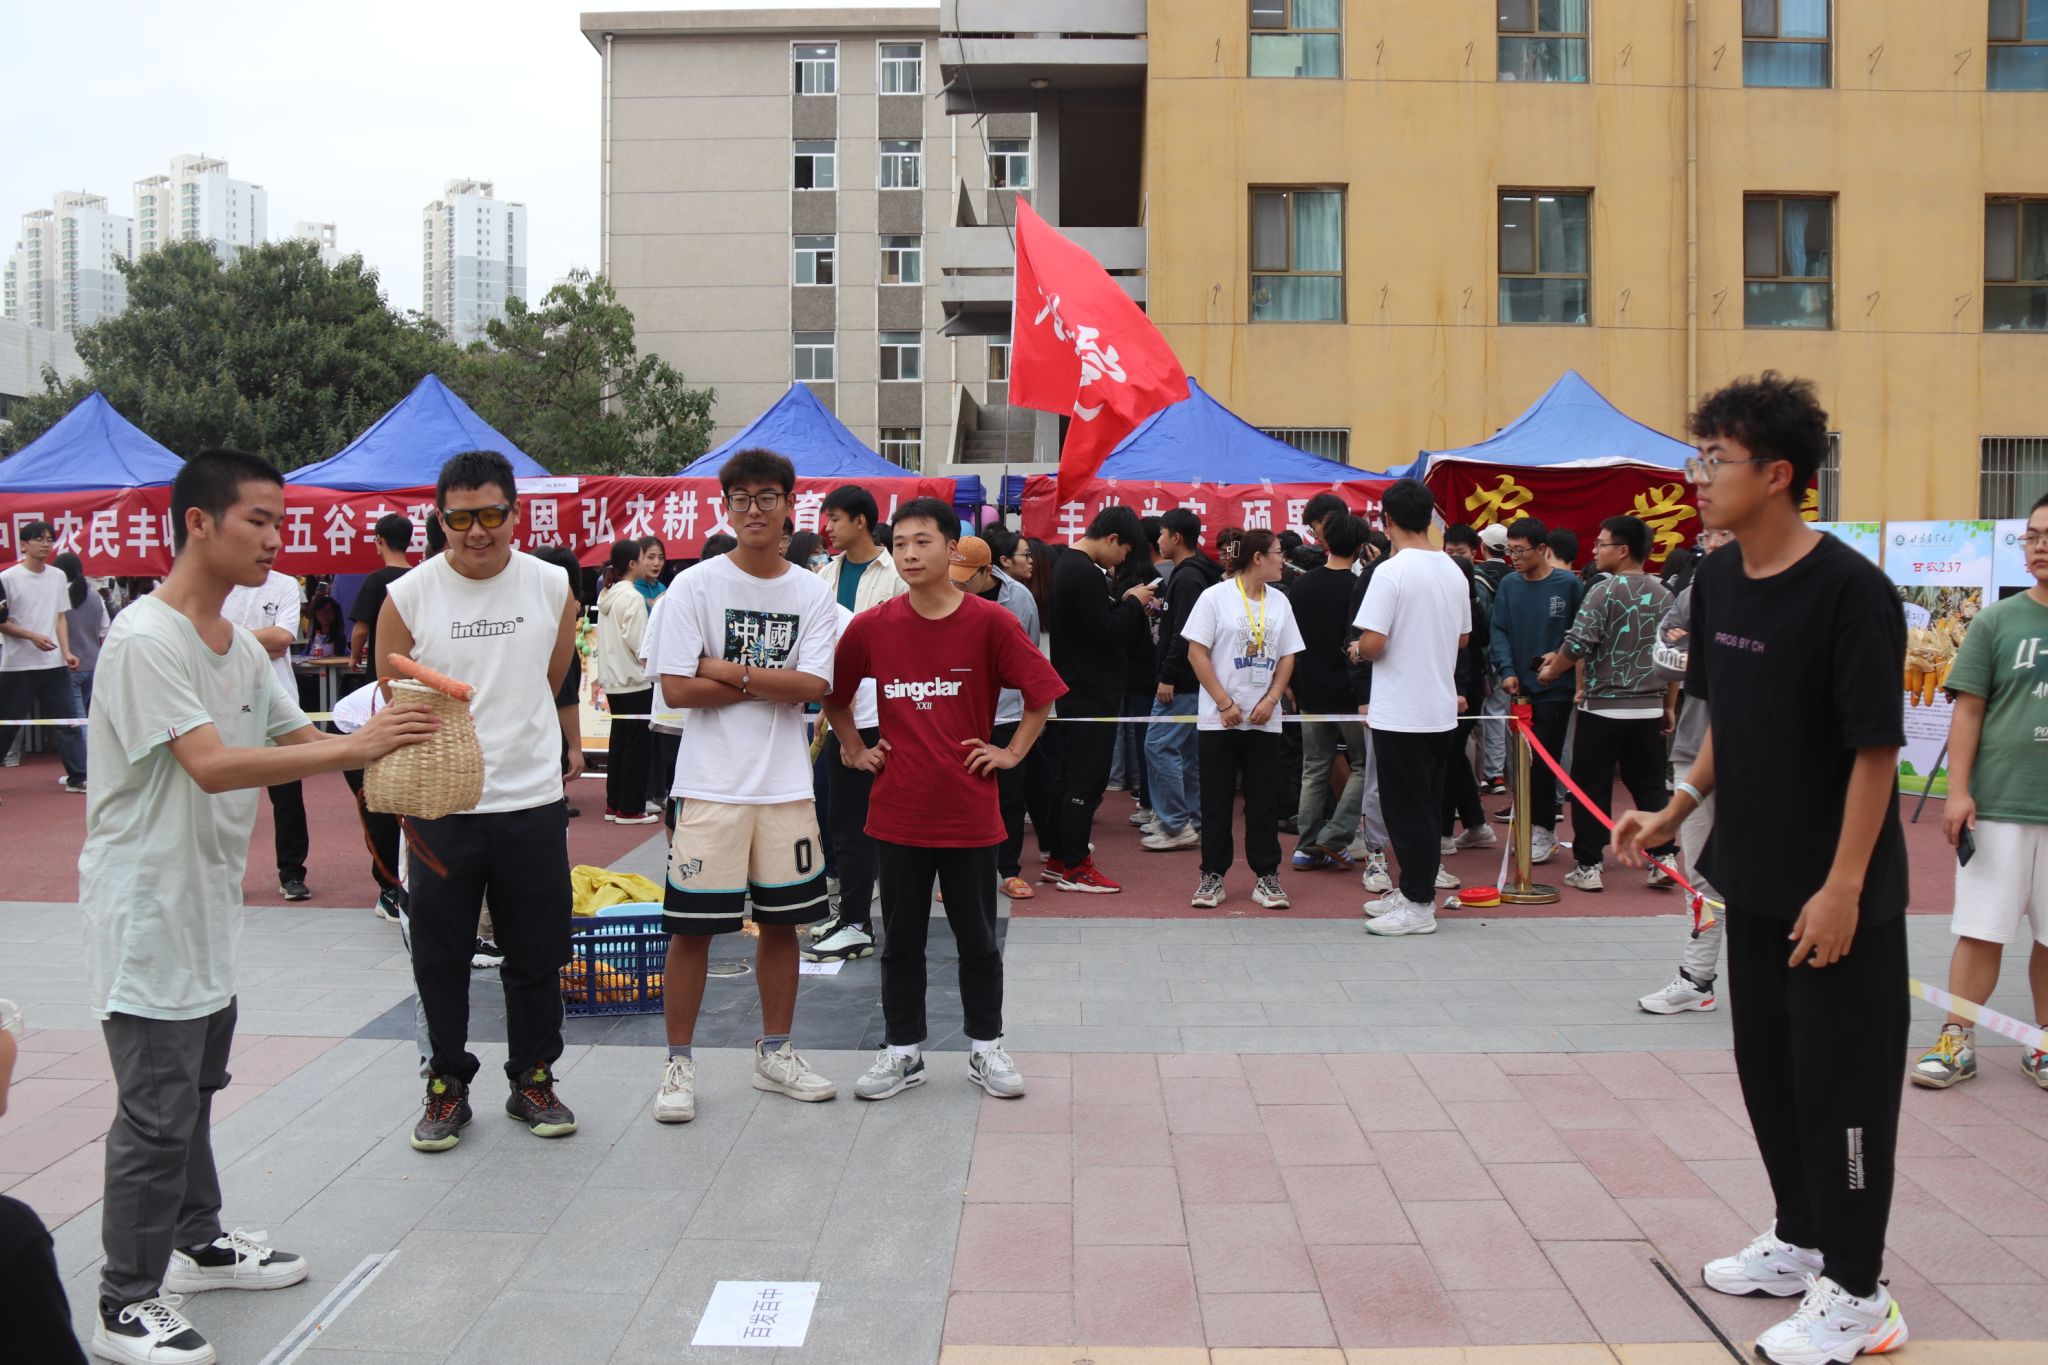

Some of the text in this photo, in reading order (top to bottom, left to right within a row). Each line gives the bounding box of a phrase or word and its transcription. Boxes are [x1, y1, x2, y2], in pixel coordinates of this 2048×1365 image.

[451, 619, 515, 639] intima
[1658, 649, 1685, 669] STYLE
[884, 677, 962, 701] singclar
